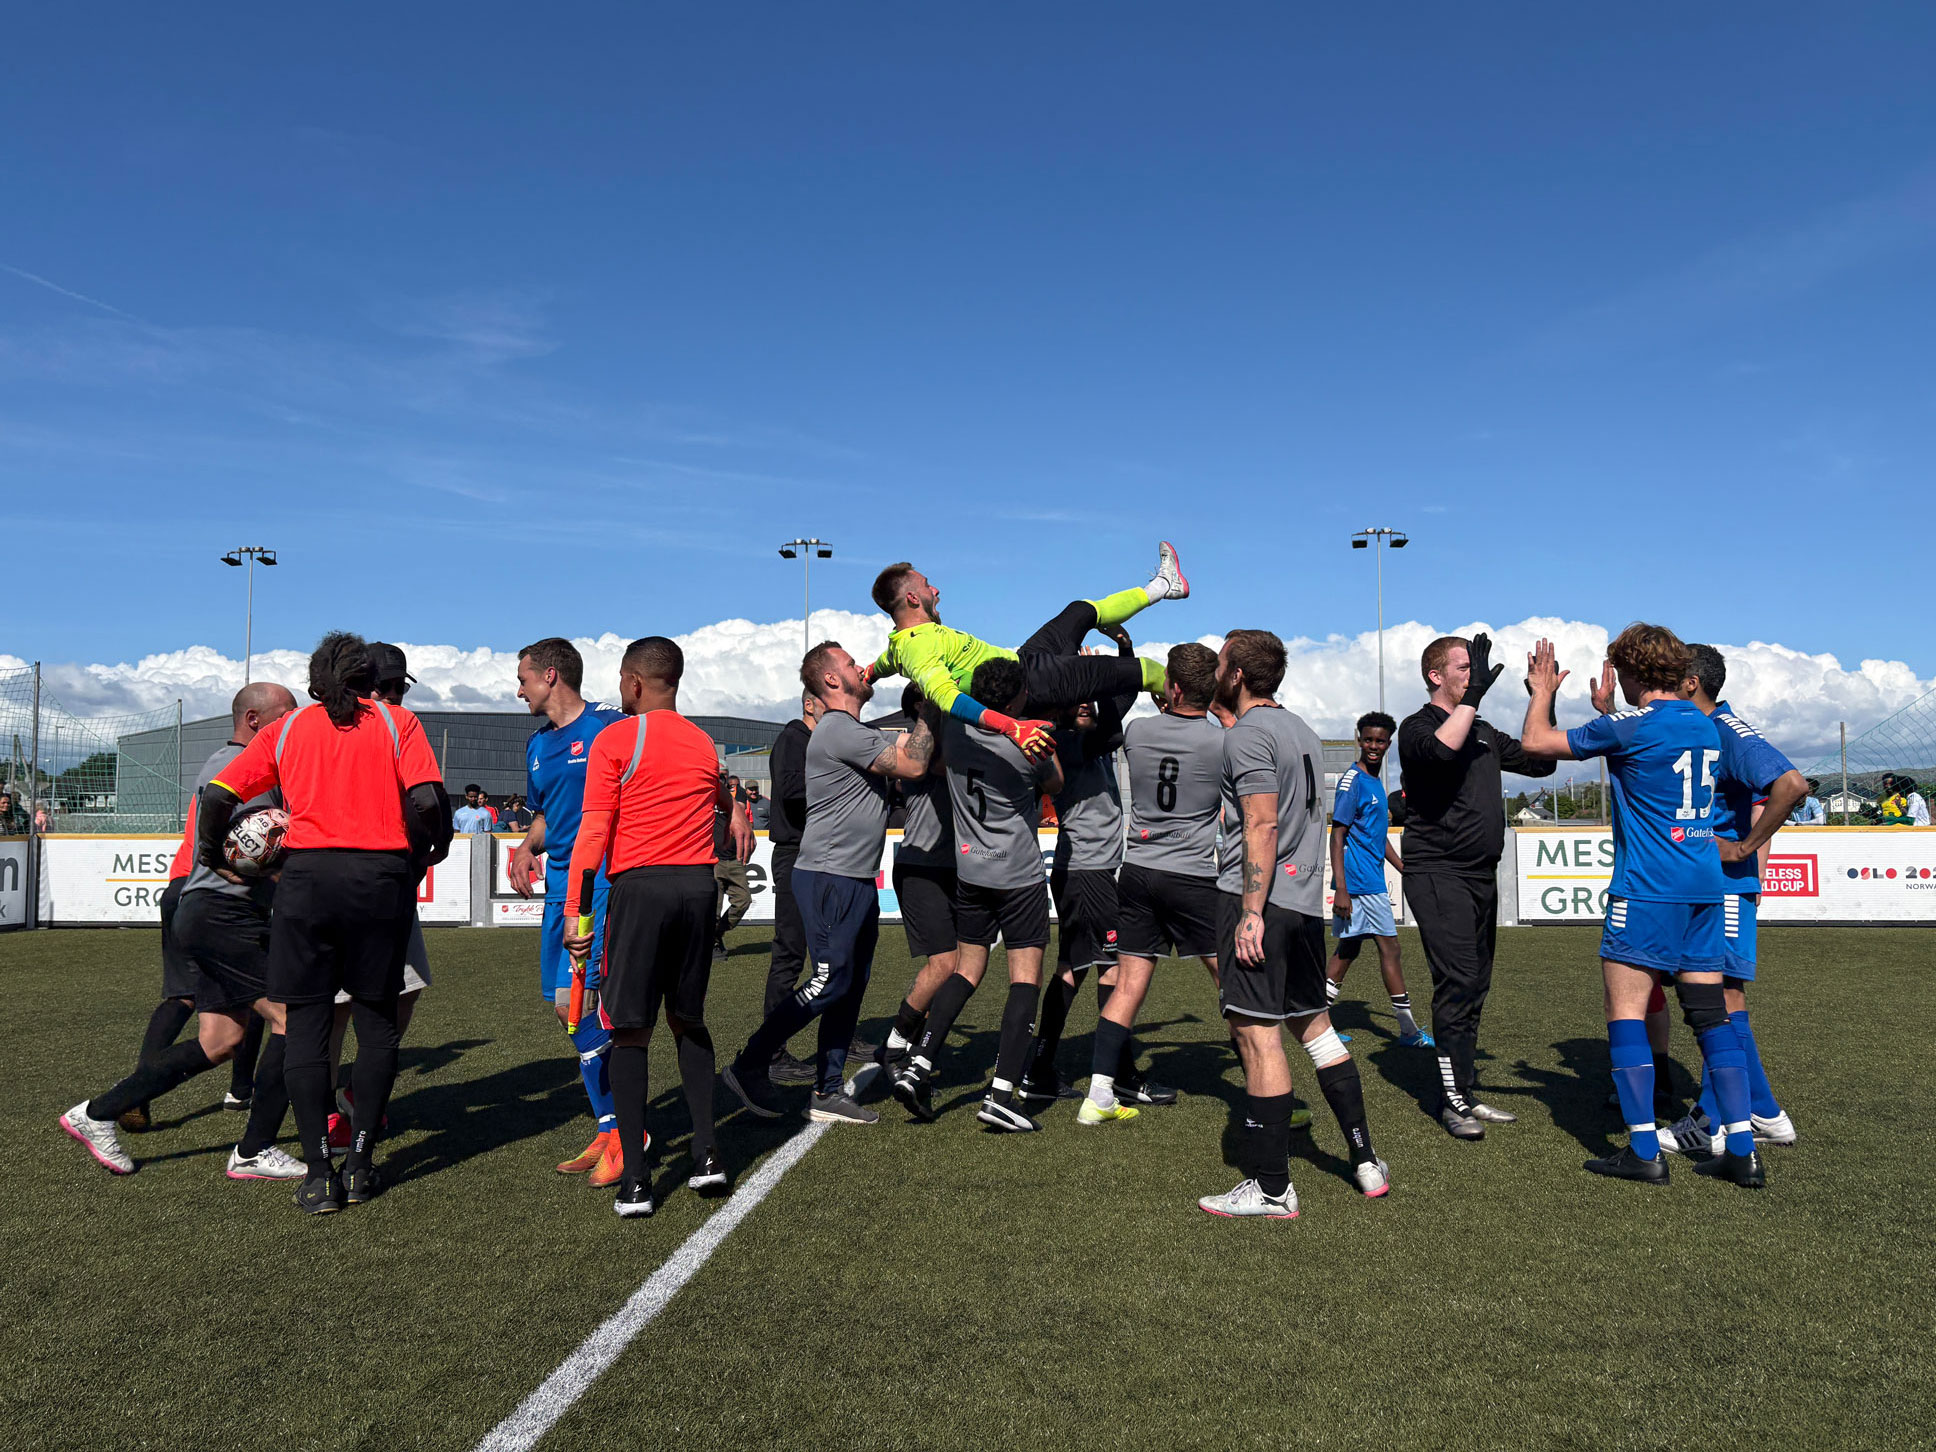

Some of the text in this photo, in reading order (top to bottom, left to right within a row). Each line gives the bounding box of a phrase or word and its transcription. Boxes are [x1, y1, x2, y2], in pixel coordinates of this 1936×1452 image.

[967, 768, 986, 823] 5
[1157, 756, 1179, 812] 8
[1672, 749, 1720, 819] 15
[233, 825, 261, 853] ELECT
[1765, 868, 1802, 879] ELESS
[1847, 867, 1897, 880] OSLO
[1780, 881, 1805, 891] CUP
[320, 1136, 329, 1159] umbro
[355, 1130, 366, 1153] umbro
[1352, 1127, 1364, 1148] umbro
